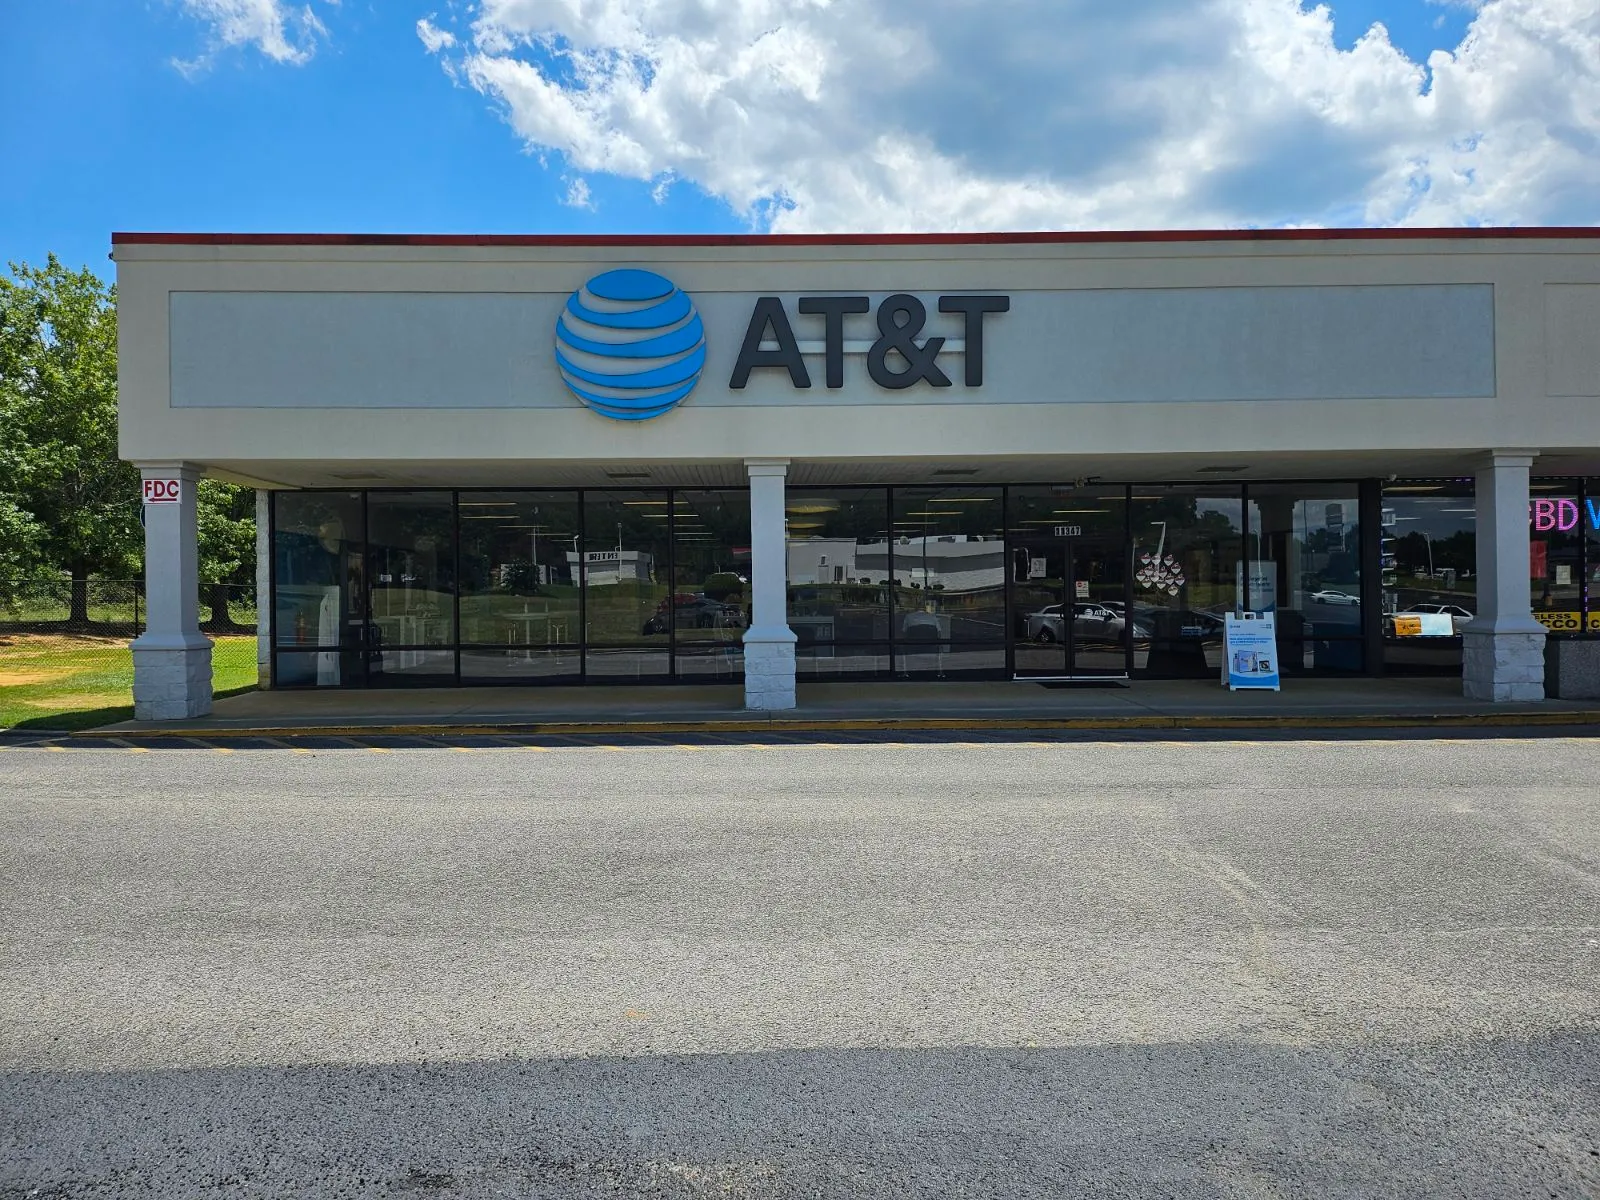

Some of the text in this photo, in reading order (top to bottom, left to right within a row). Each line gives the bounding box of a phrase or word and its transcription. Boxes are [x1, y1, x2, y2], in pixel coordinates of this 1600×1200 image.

[729, 294, 1009, 389] AT&T
[145, 481, 179, 497] FDC
[1529, 498, 1578, 530] BD
